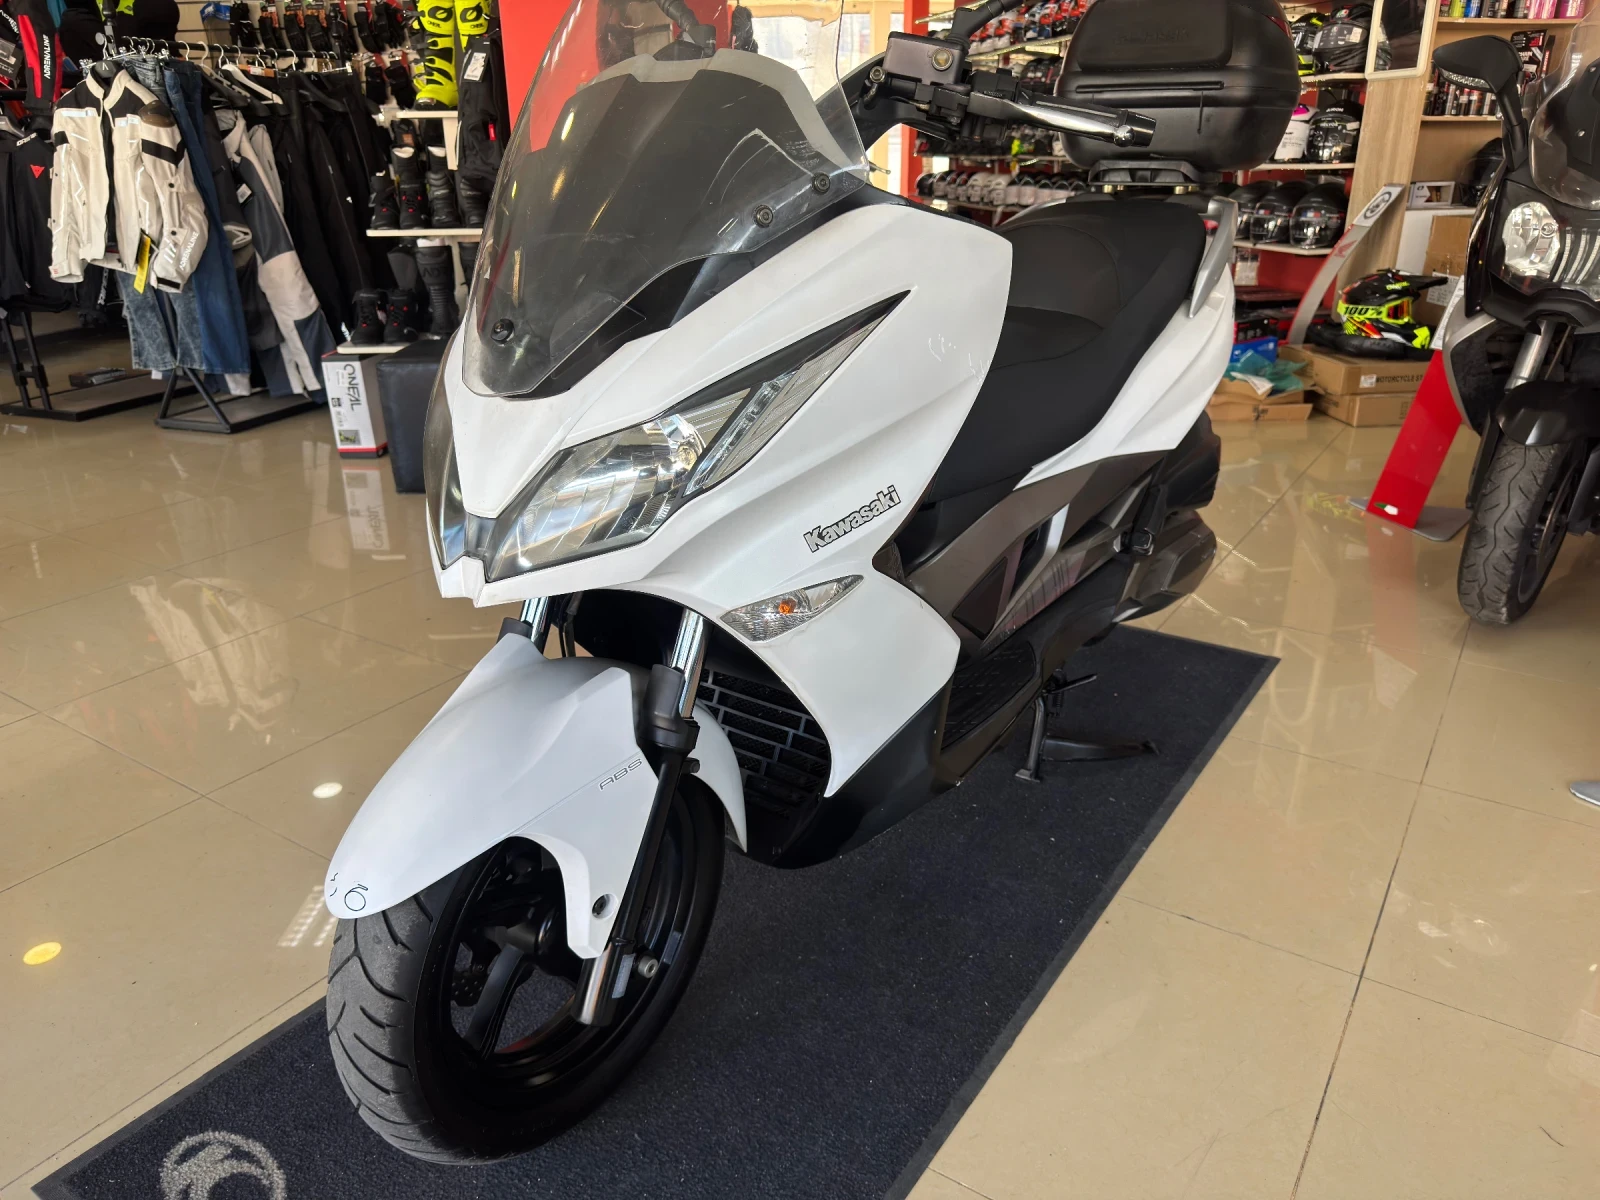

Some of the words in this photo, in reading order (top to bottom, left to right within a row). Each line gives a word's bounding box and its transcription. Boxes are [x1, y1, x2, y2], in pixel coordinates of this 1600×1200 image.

[42, 34, 51, 80] ADRENALINE
[179, 231, 200, 271] ADRENALINE
[1344, 306, 1383, 316] 100%
[803, 484, 901, 554] Kawasaki
[599, 758, 643, 791] ABS
